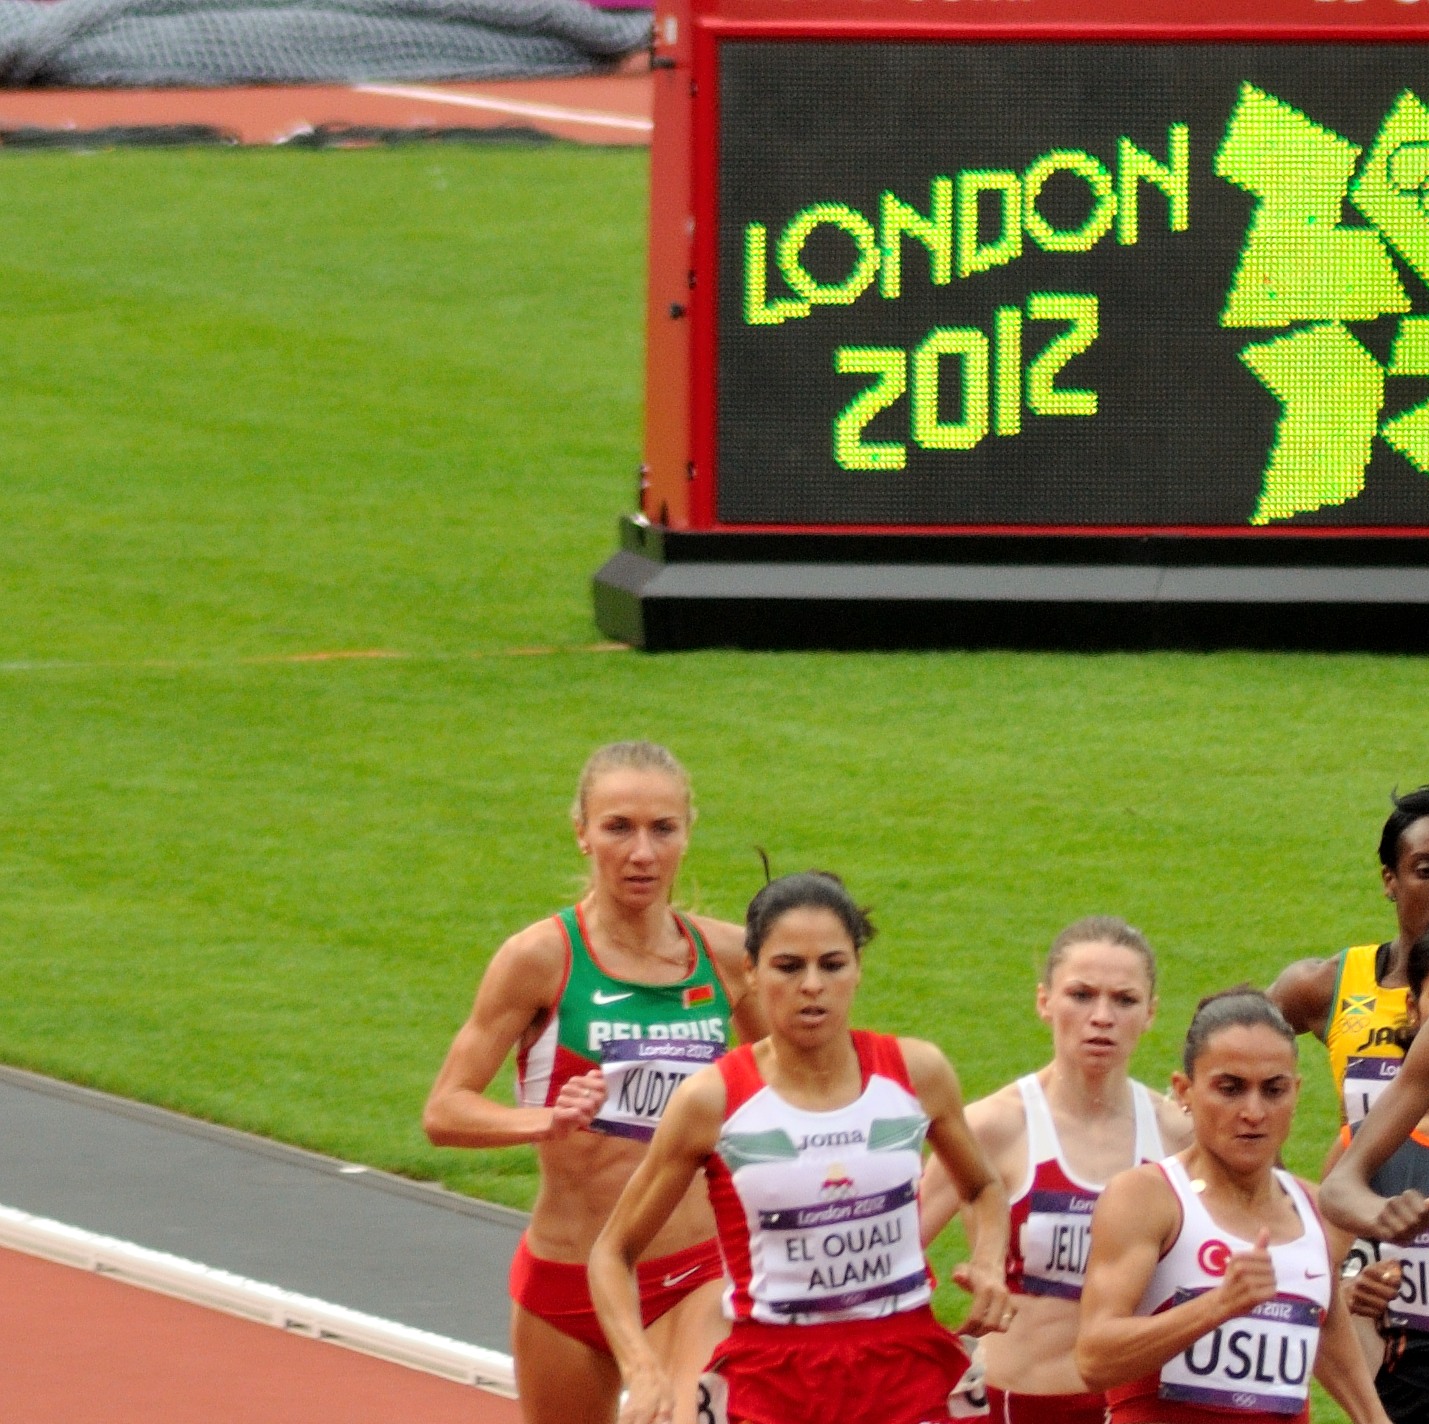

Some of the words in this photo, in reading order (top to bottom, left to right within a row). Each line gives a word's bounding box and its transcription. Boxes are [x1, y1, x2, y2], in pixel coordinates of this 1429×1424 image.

[743, 122, 1190, 326] LONDON
[832, 290, 1100, 472] 2012
[785, 1236, 816, 1262] EL
[807, 1253, 893, 1292] ALAMI
[1184, 1328, 1308, 1386] USLU
